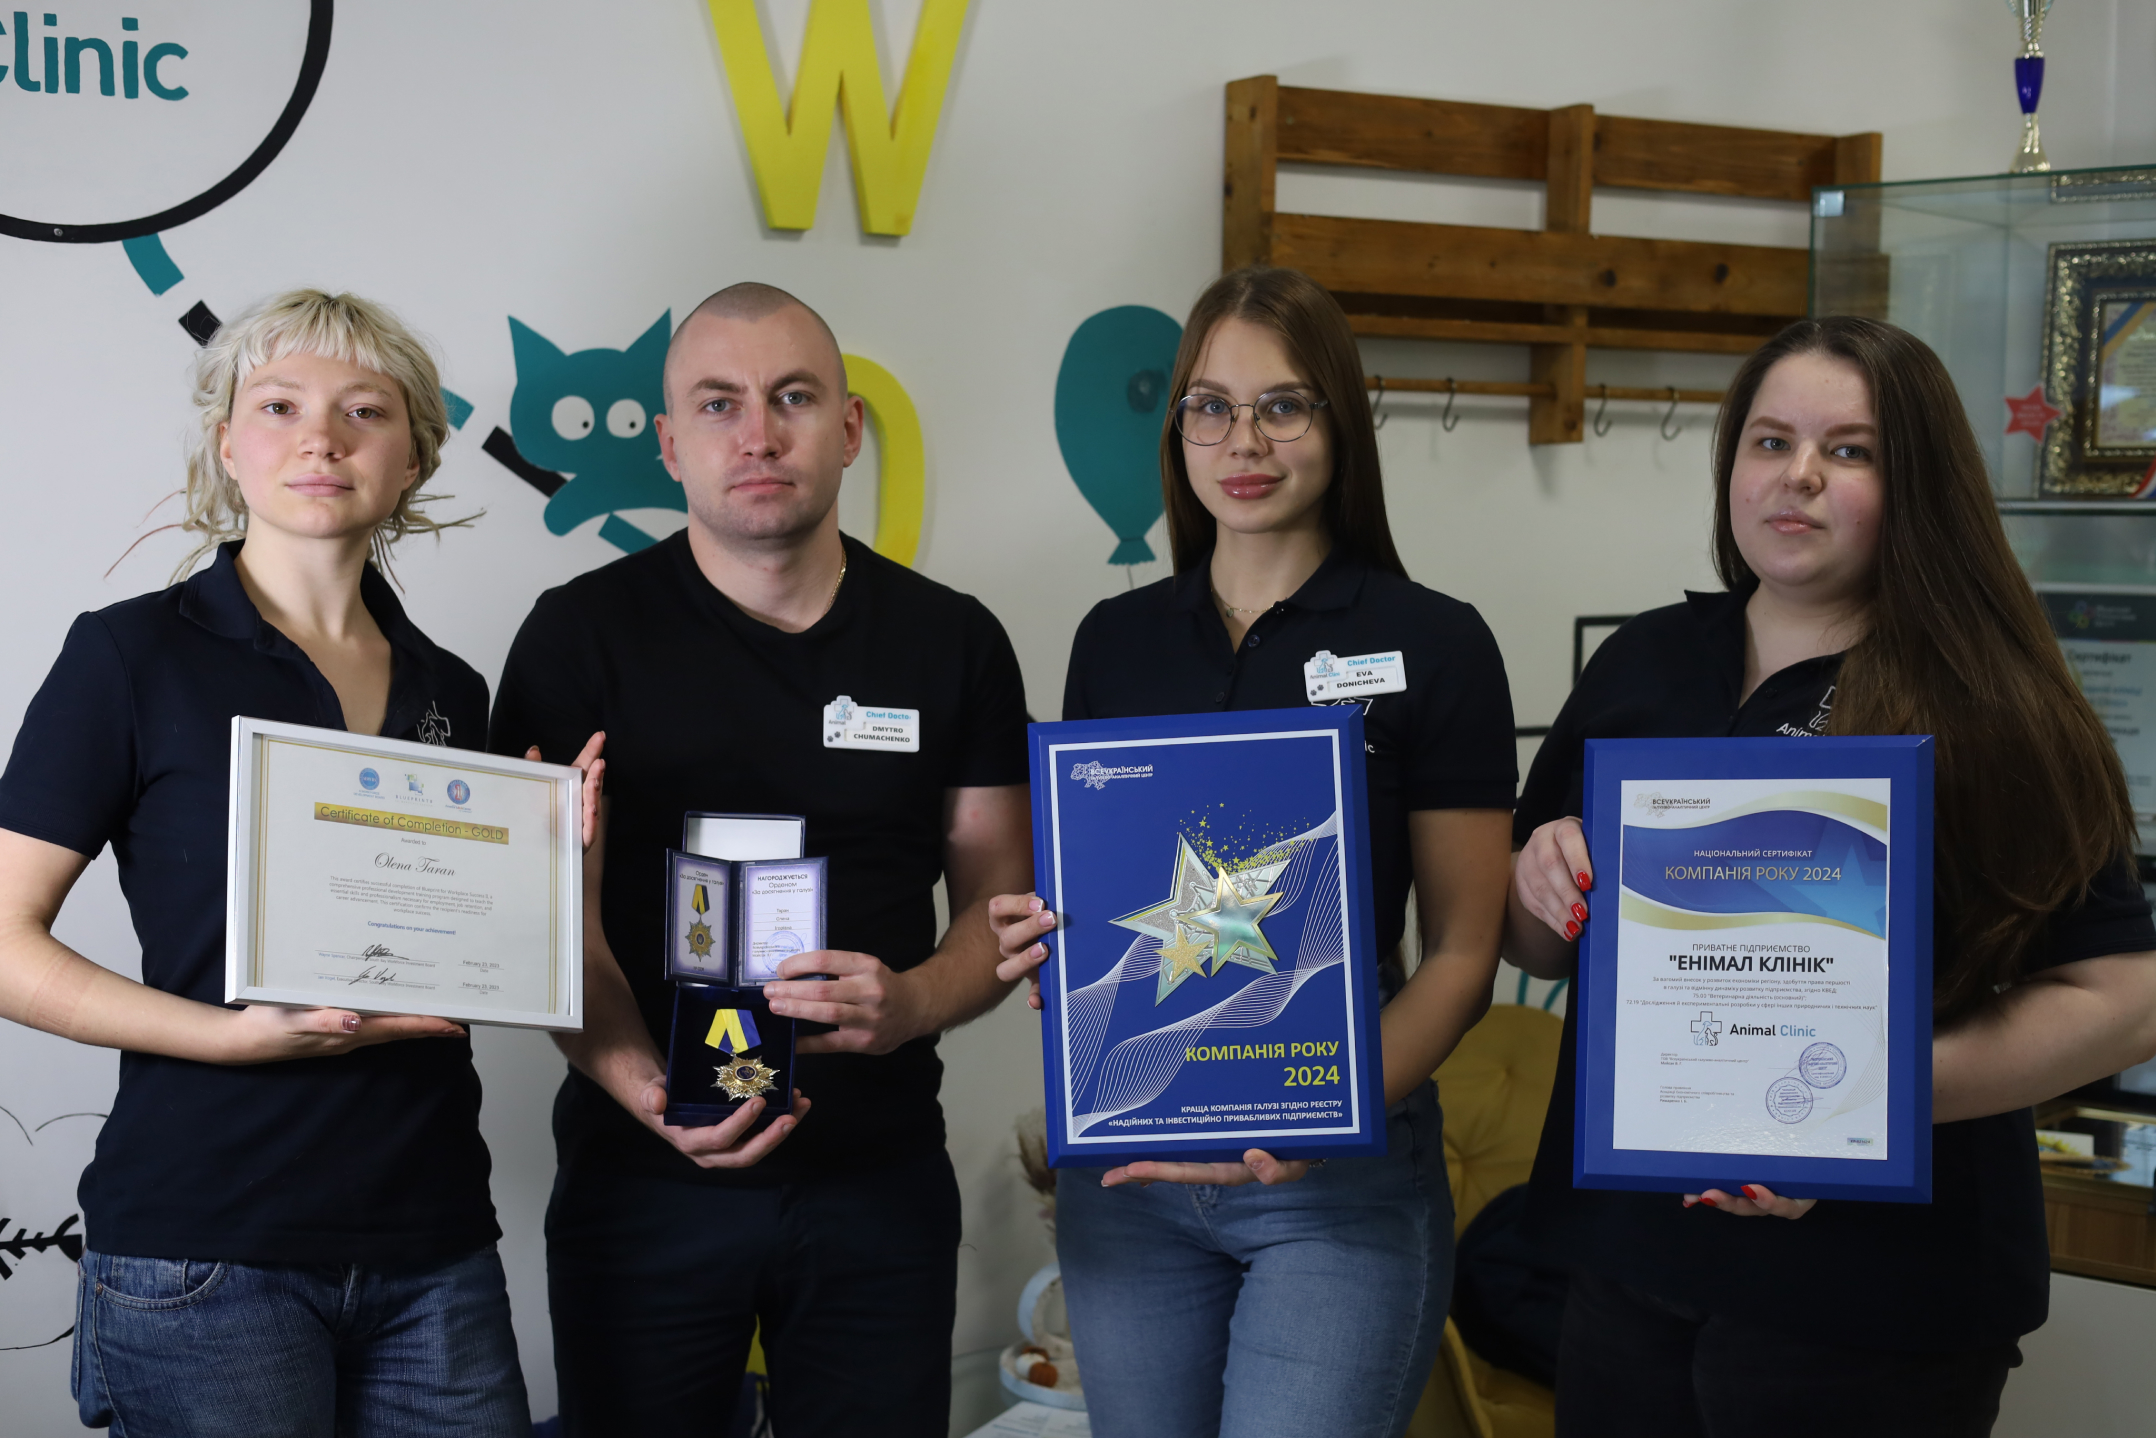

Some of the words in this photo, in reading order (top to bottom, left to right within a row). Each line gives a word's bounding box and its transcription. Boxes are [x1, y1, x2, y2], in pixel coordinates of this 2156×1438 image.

[0, 11, 189, 101] linic
[1347, 658, 1368, 667] Chief
[1369, 655, 1396, 665] Doctor
[1356, 670, 1374, 678] EVA
[1336, 677, 1386, 689] DONICHEVA
[866, 710, 886, 719] Chief
[872, 725, 904, 734] DMYTRO
[1776, 722, 1826, 737] Anim
[853, 733, 911, 743] CHUMACHENKO
[320, 806, 380, 824] Certificate
[383, 815, 395, 826] of
[397, 816, 462, 835] Completion
[471, 826, 504, 840] GOLD
[401, 837, 421, 845] Awarded
[1694, 848, 1761, 858] НАЦІОНАЛЬНИЙ
[1762, 850, 1813, 858] СЕРТИФІКАТ
[374, 852, 412, 872] Olena
[415, 856, 456, 877] Taran
[757, 873, 808, 882] НАГОРОДЖУЄТЬСЯ
[1665, 866, 1751, 880] КОМПАНІЯ
[1756, 866, 1799, 881] РОКУ
[1803, 867, 1842, 881] 2024
[367, 920, 406, 930] Congratulations
[425, 927, 457, 935] achievement!
[1692, 943, 1737, 952] ПРИВАТНЕ
[1740, 944, 1811, 953] ПІДПРИЄМСТВО
[1669, 954, 1753, 972] "ЕНІМАЛ
[1759, 956, 1834, 973] КЛІНІК"
[1729, 1024, 1776, 1036] Animal
[1780, 1024, 1817, 1037] Clinic
[1185, 1043, 1285, 1062] КОМПАНІЯ
[1291, 1041, 1340, 1058] РОКУ
[1283, 1065, 1341, 1087] 2024
[1181, 1105, 1209, 1114] КРАЩА
[1210, 1103, 1252, 1113] КОМПАНІЯ
[1254, 1102, 1279, 1111] ГАЛУЗІ
[1280, 1101, 1309, 1111] ЗГІДНО
[1310, 1100, 1343, 1109] РЕЄСТРУ
[1108, 1117, 1153, 1128] «НАДІЙНИХ
[1165, 1114, 1222, 1126] ІНВЕСТИЦІЙНО
[1223, 1113, 1281, 1123] ПРИВАБЛИВИХ
[1282, 1111, 1343, 1122] ПІДПРИЄМСТВ»
